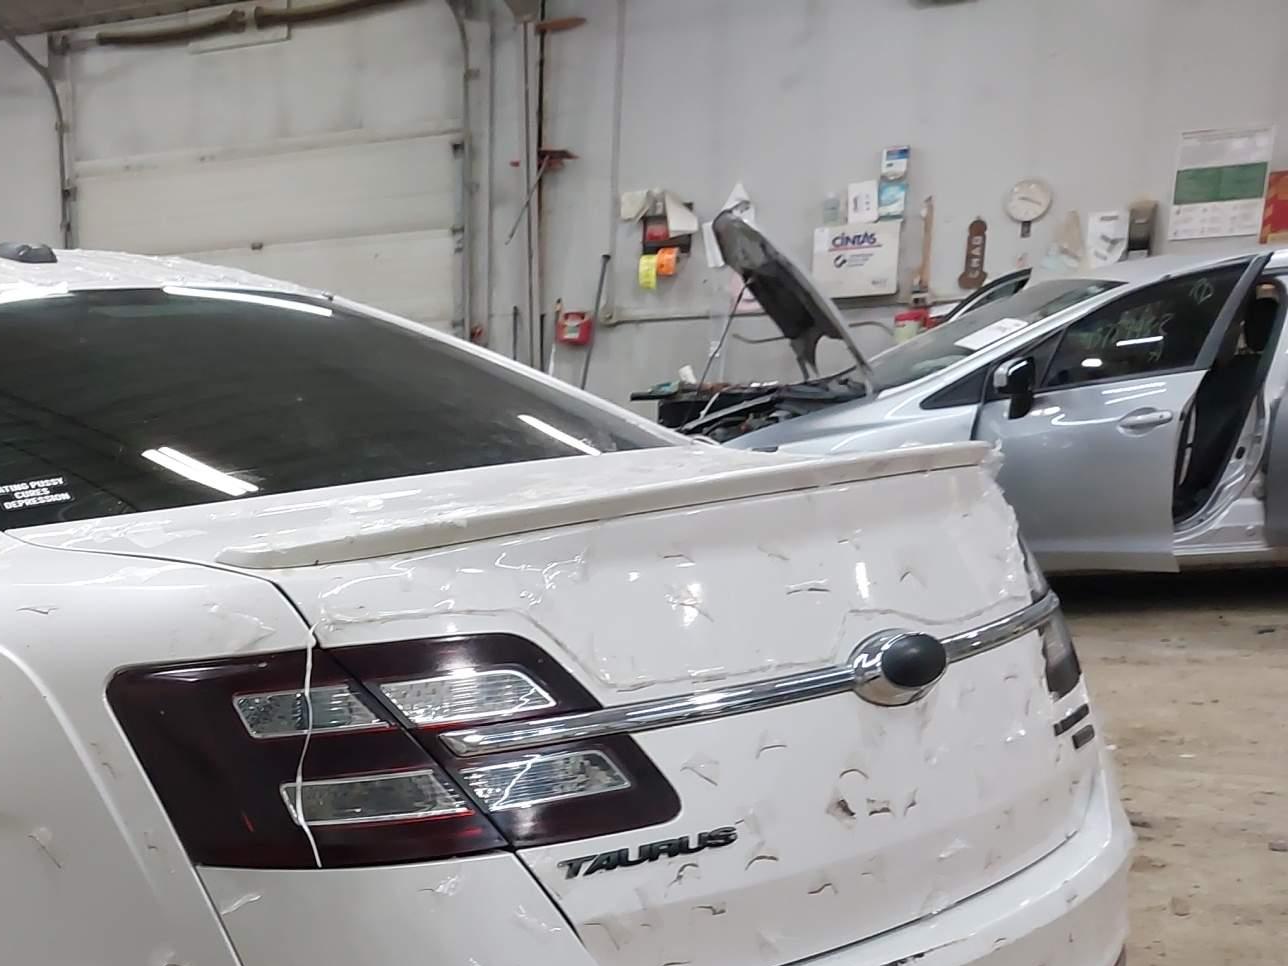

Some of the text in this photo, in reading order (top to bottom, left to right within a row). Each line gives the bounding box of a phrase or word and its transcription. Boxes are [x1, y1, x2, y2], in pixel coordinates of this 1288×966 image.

[831, 231, 877, 248] CINTAS
[29, 477, 64, 489] PUSSY
[3, 492, 71, 510] DEPRESSION
[14, 487, 50, 499] CURES
[557, 826, 738, 880] TAURUS
